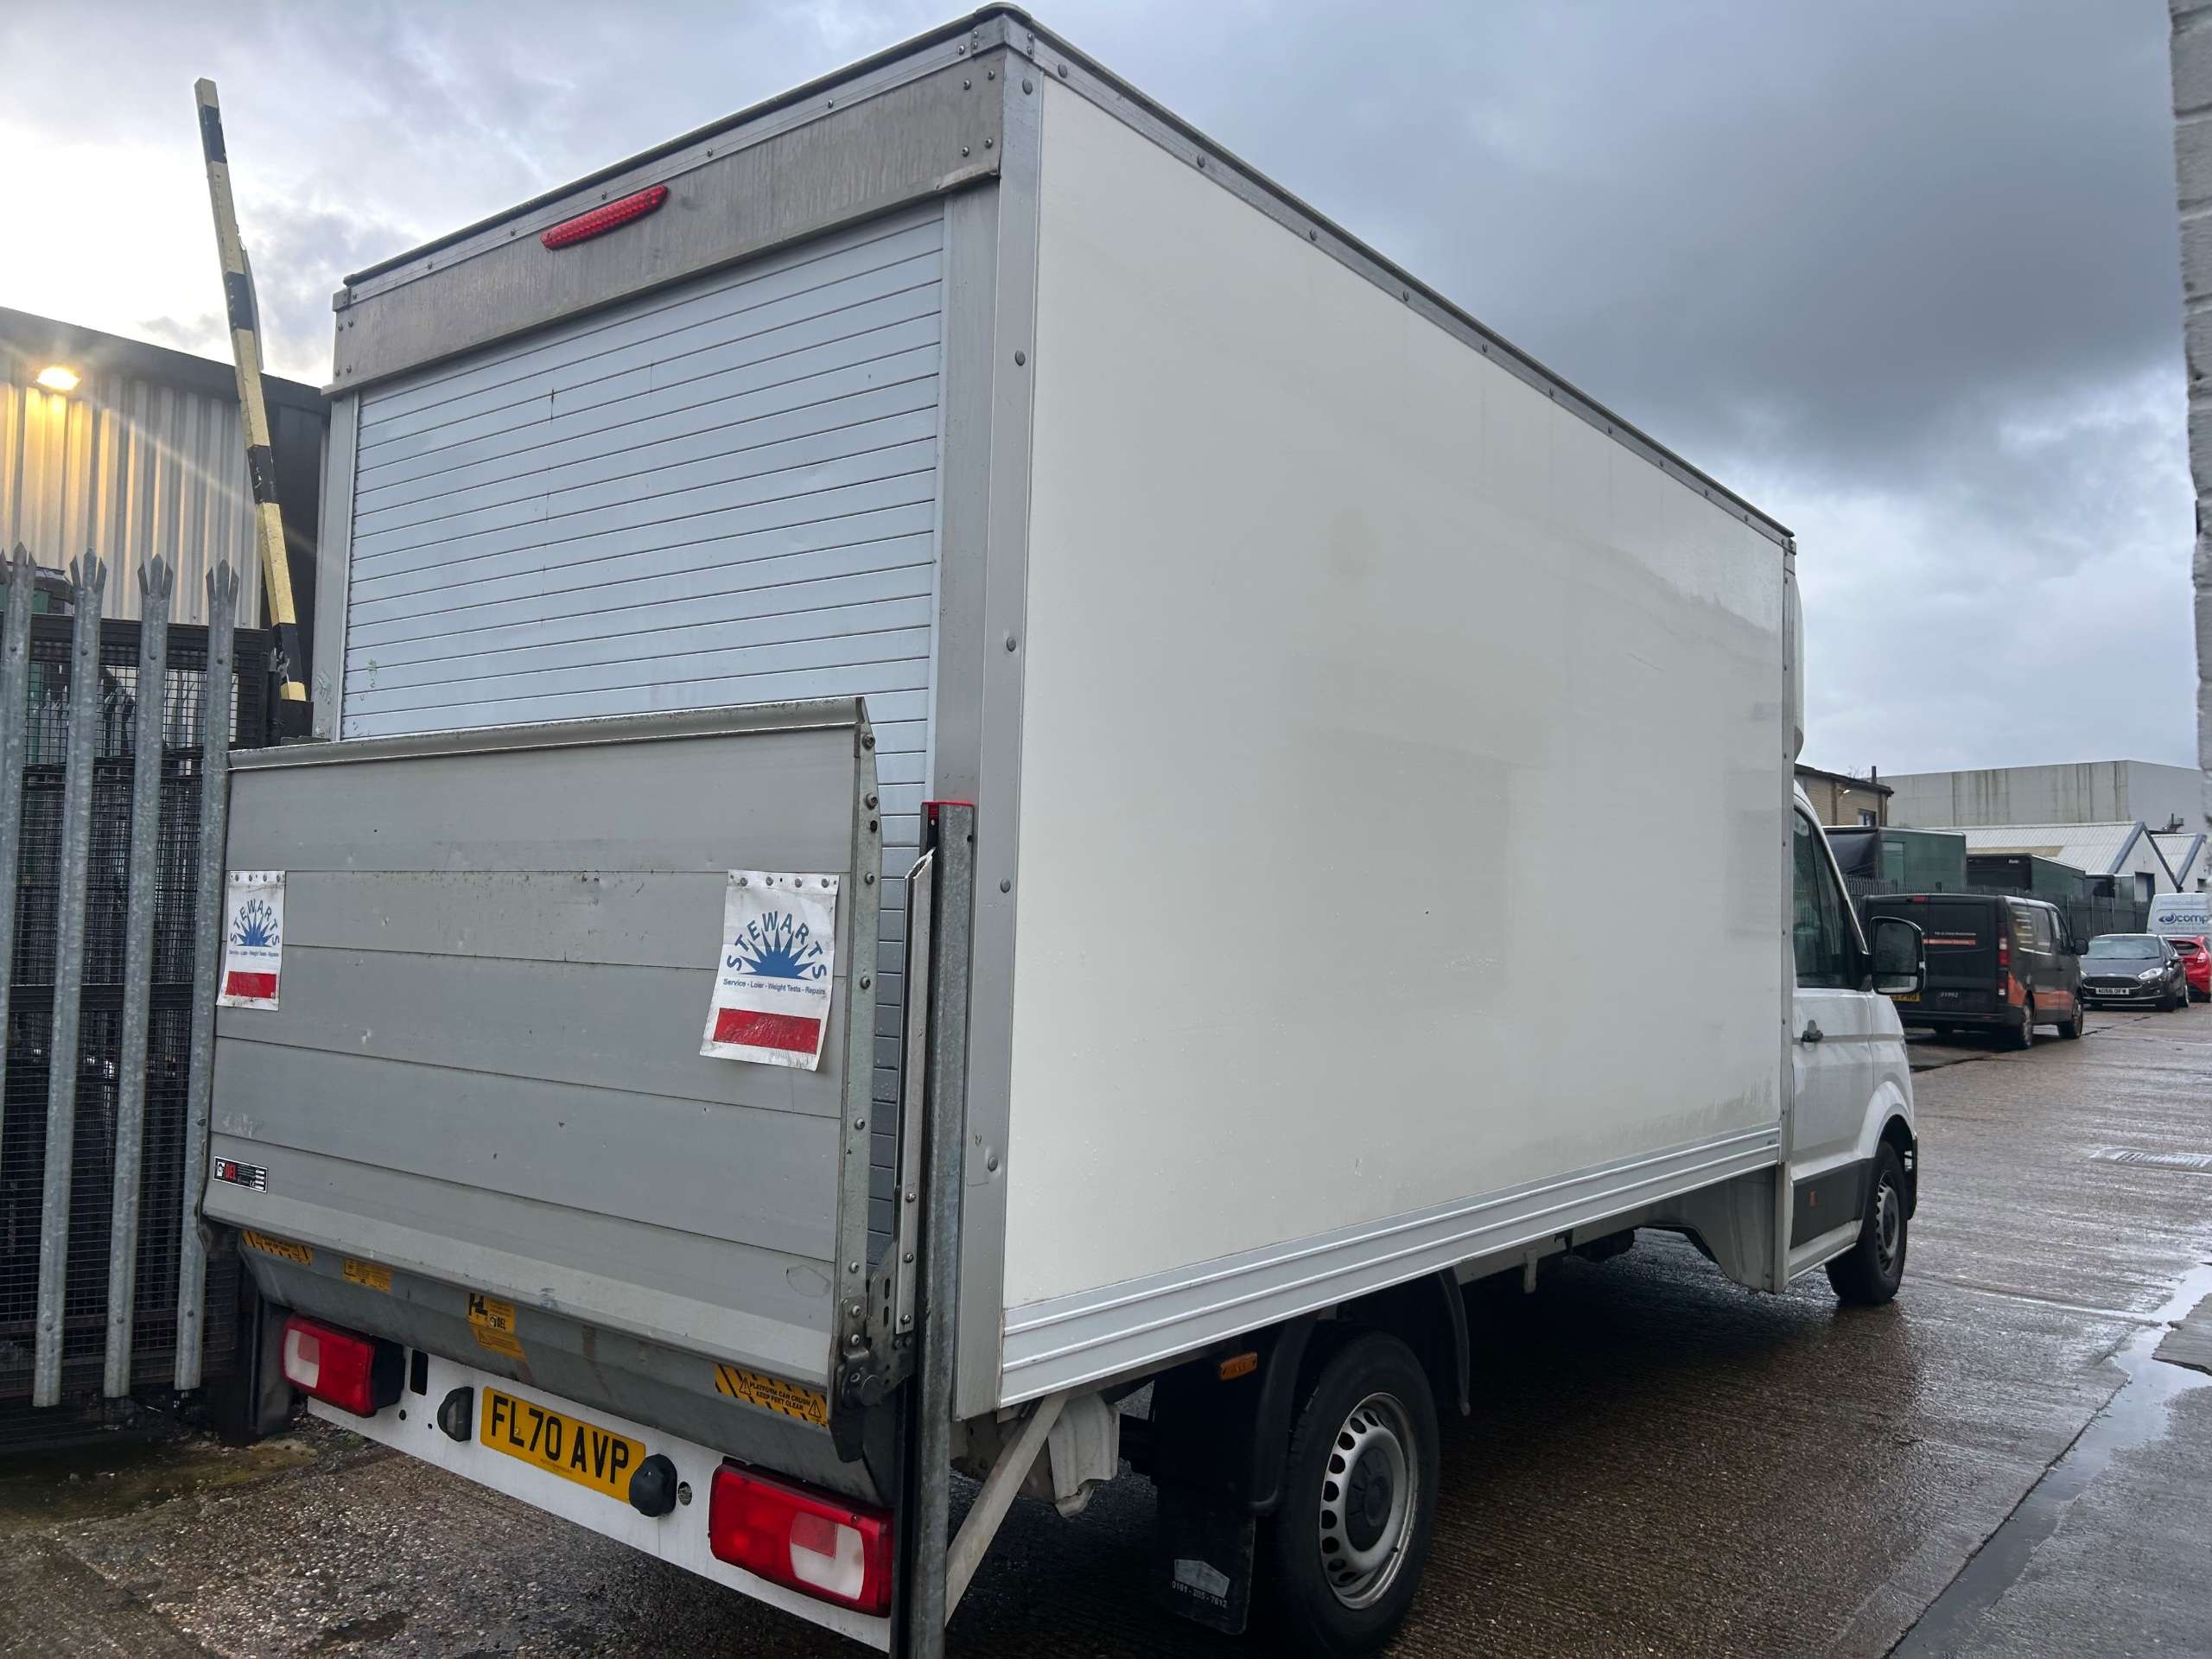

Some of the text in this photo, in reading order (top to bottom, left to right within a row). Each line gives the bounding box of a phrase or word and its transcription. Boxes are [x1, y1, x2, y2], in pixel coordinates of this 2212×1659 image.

[230, 899, 280, 946] STEWARTS
[727, 911, 827, 980] STEWARTS
[723, 978, 746, 988] Service
[767, 982, 786, 993] Weight
[787, 984, 802, 993] Tests
[771, 1395, 784, 1406] FEET
[785, 1400, 804, 1411] CLEAR
[491, 1395, 629, 1485] FL70 AVP
